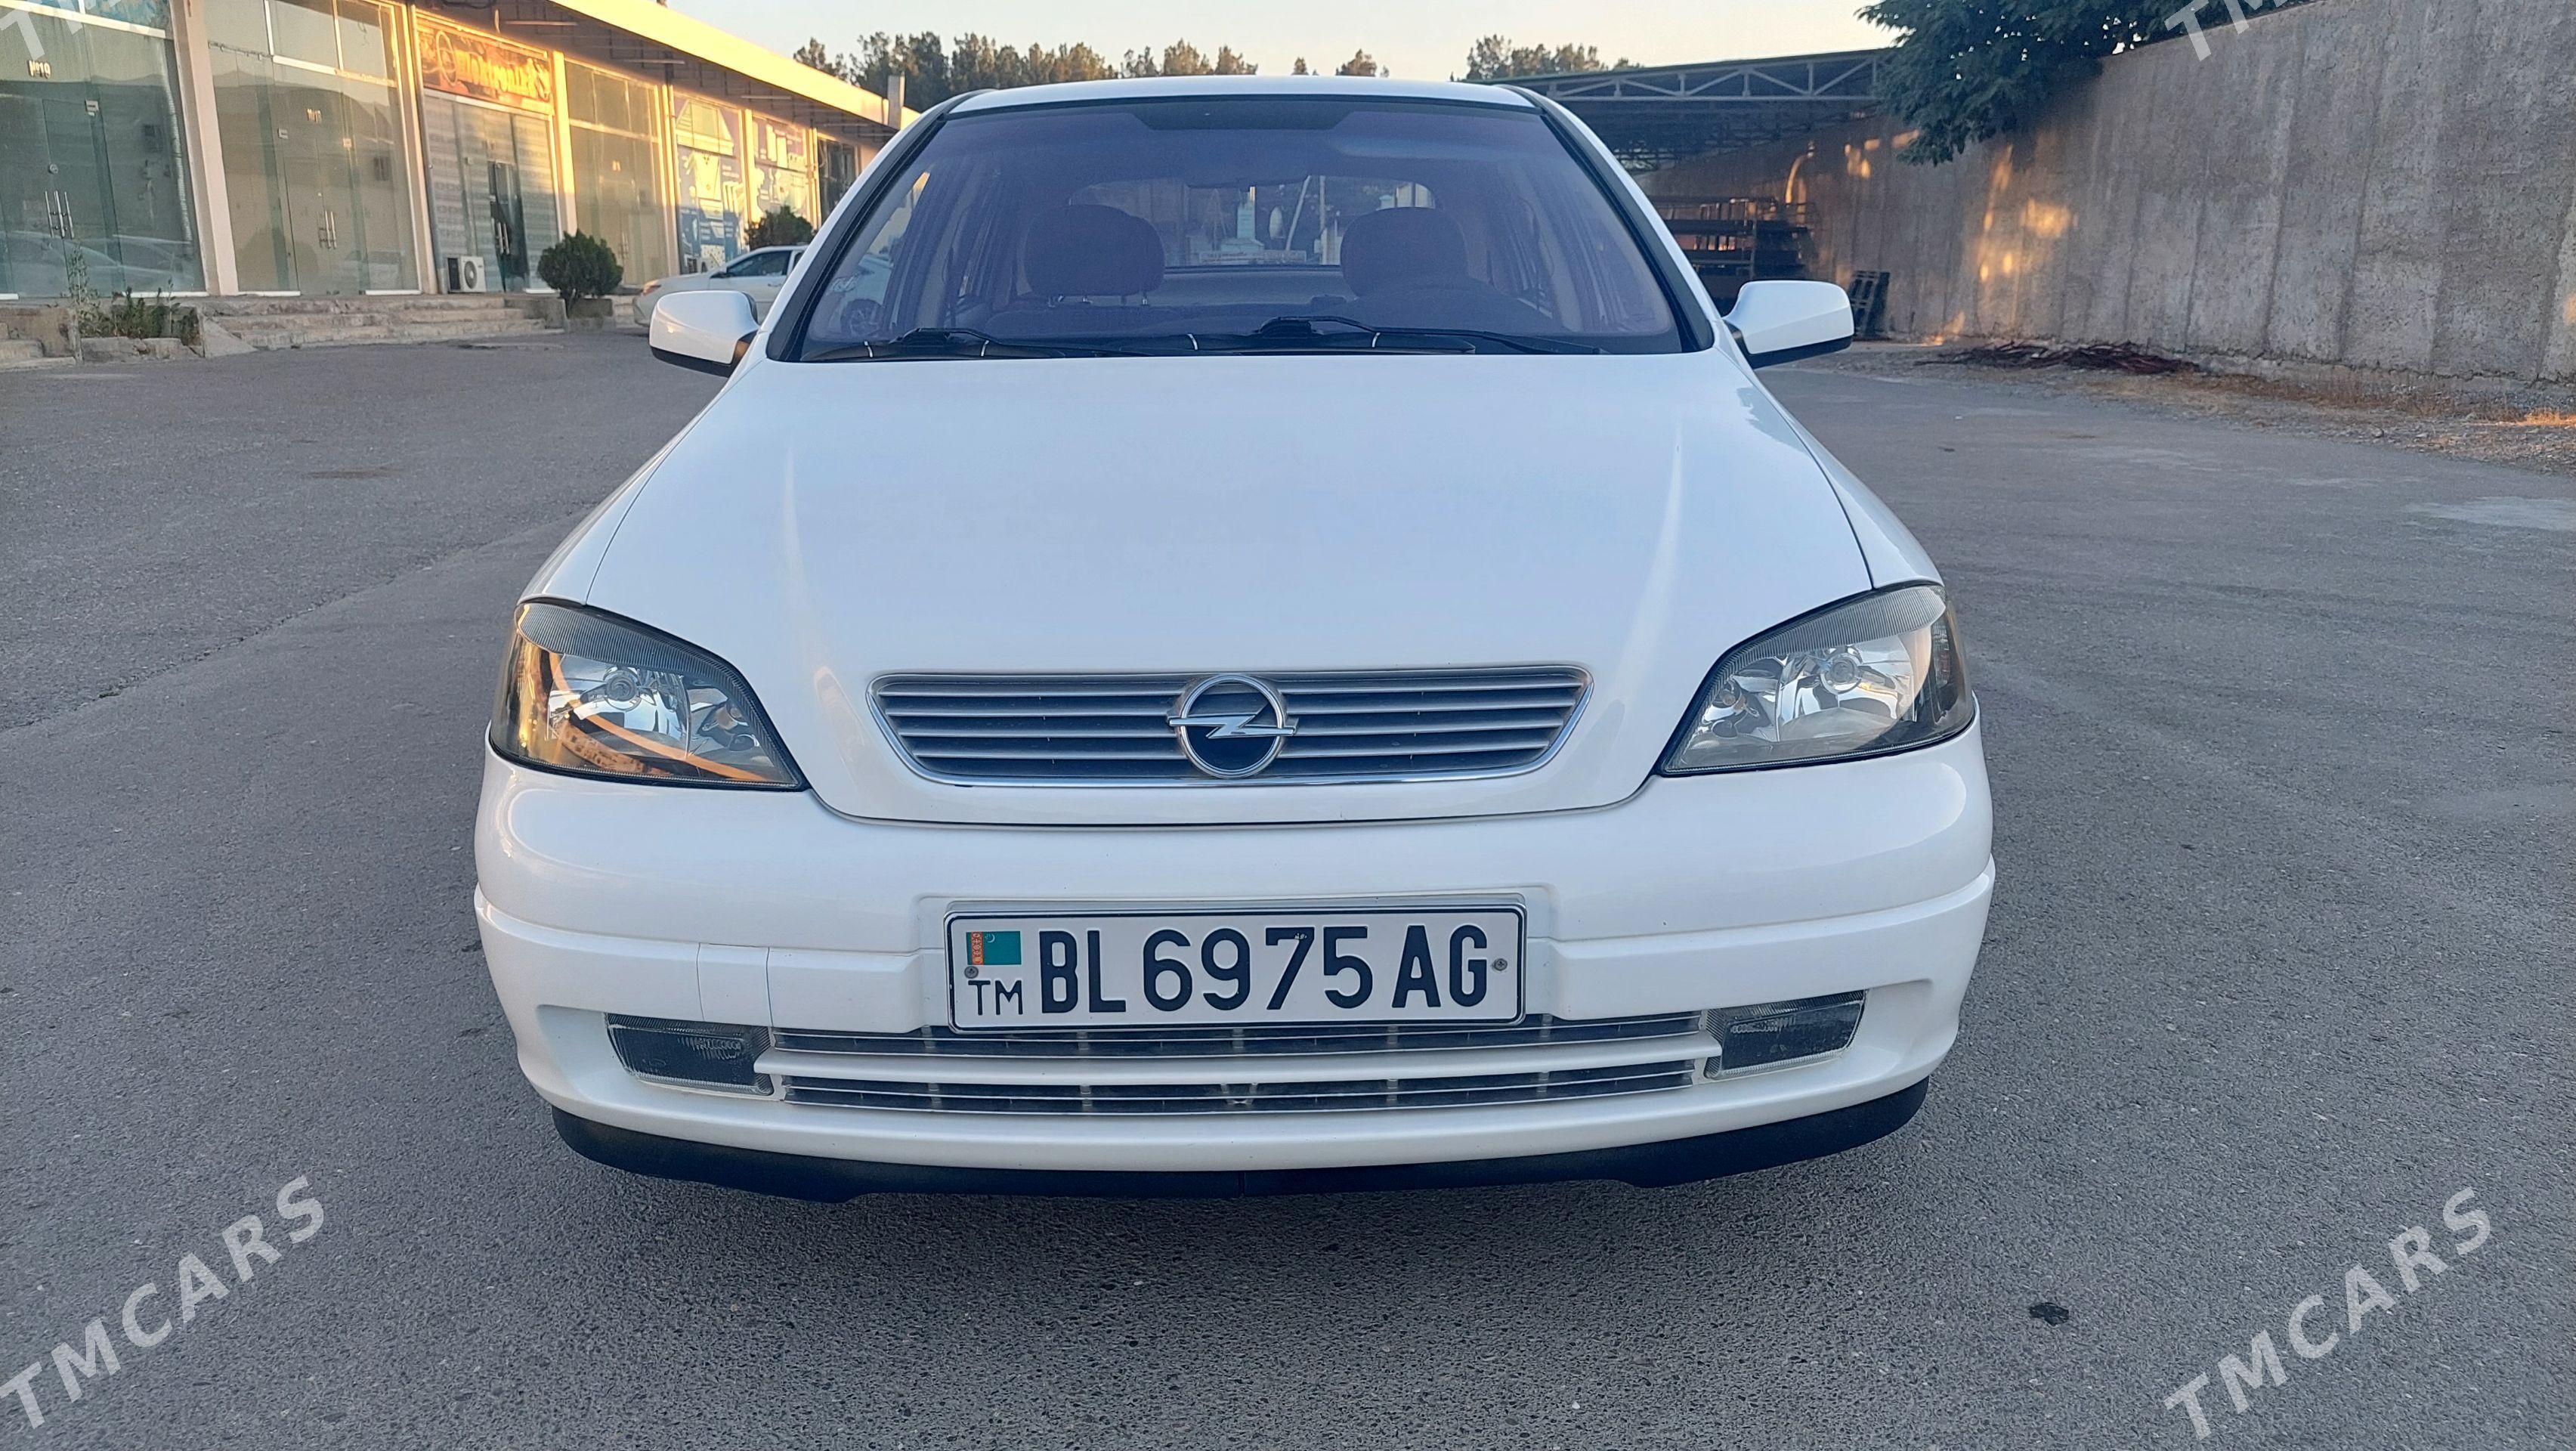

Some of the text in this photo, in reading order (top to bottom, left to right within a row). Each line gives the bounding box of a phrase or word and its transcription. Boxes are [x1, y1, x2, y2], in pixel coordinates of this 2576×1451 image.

[968, 979, 1023, 1016] TM
[1143, 925, 1373, 1012] 6975
[1392, 924, 1488, 1008] AG
